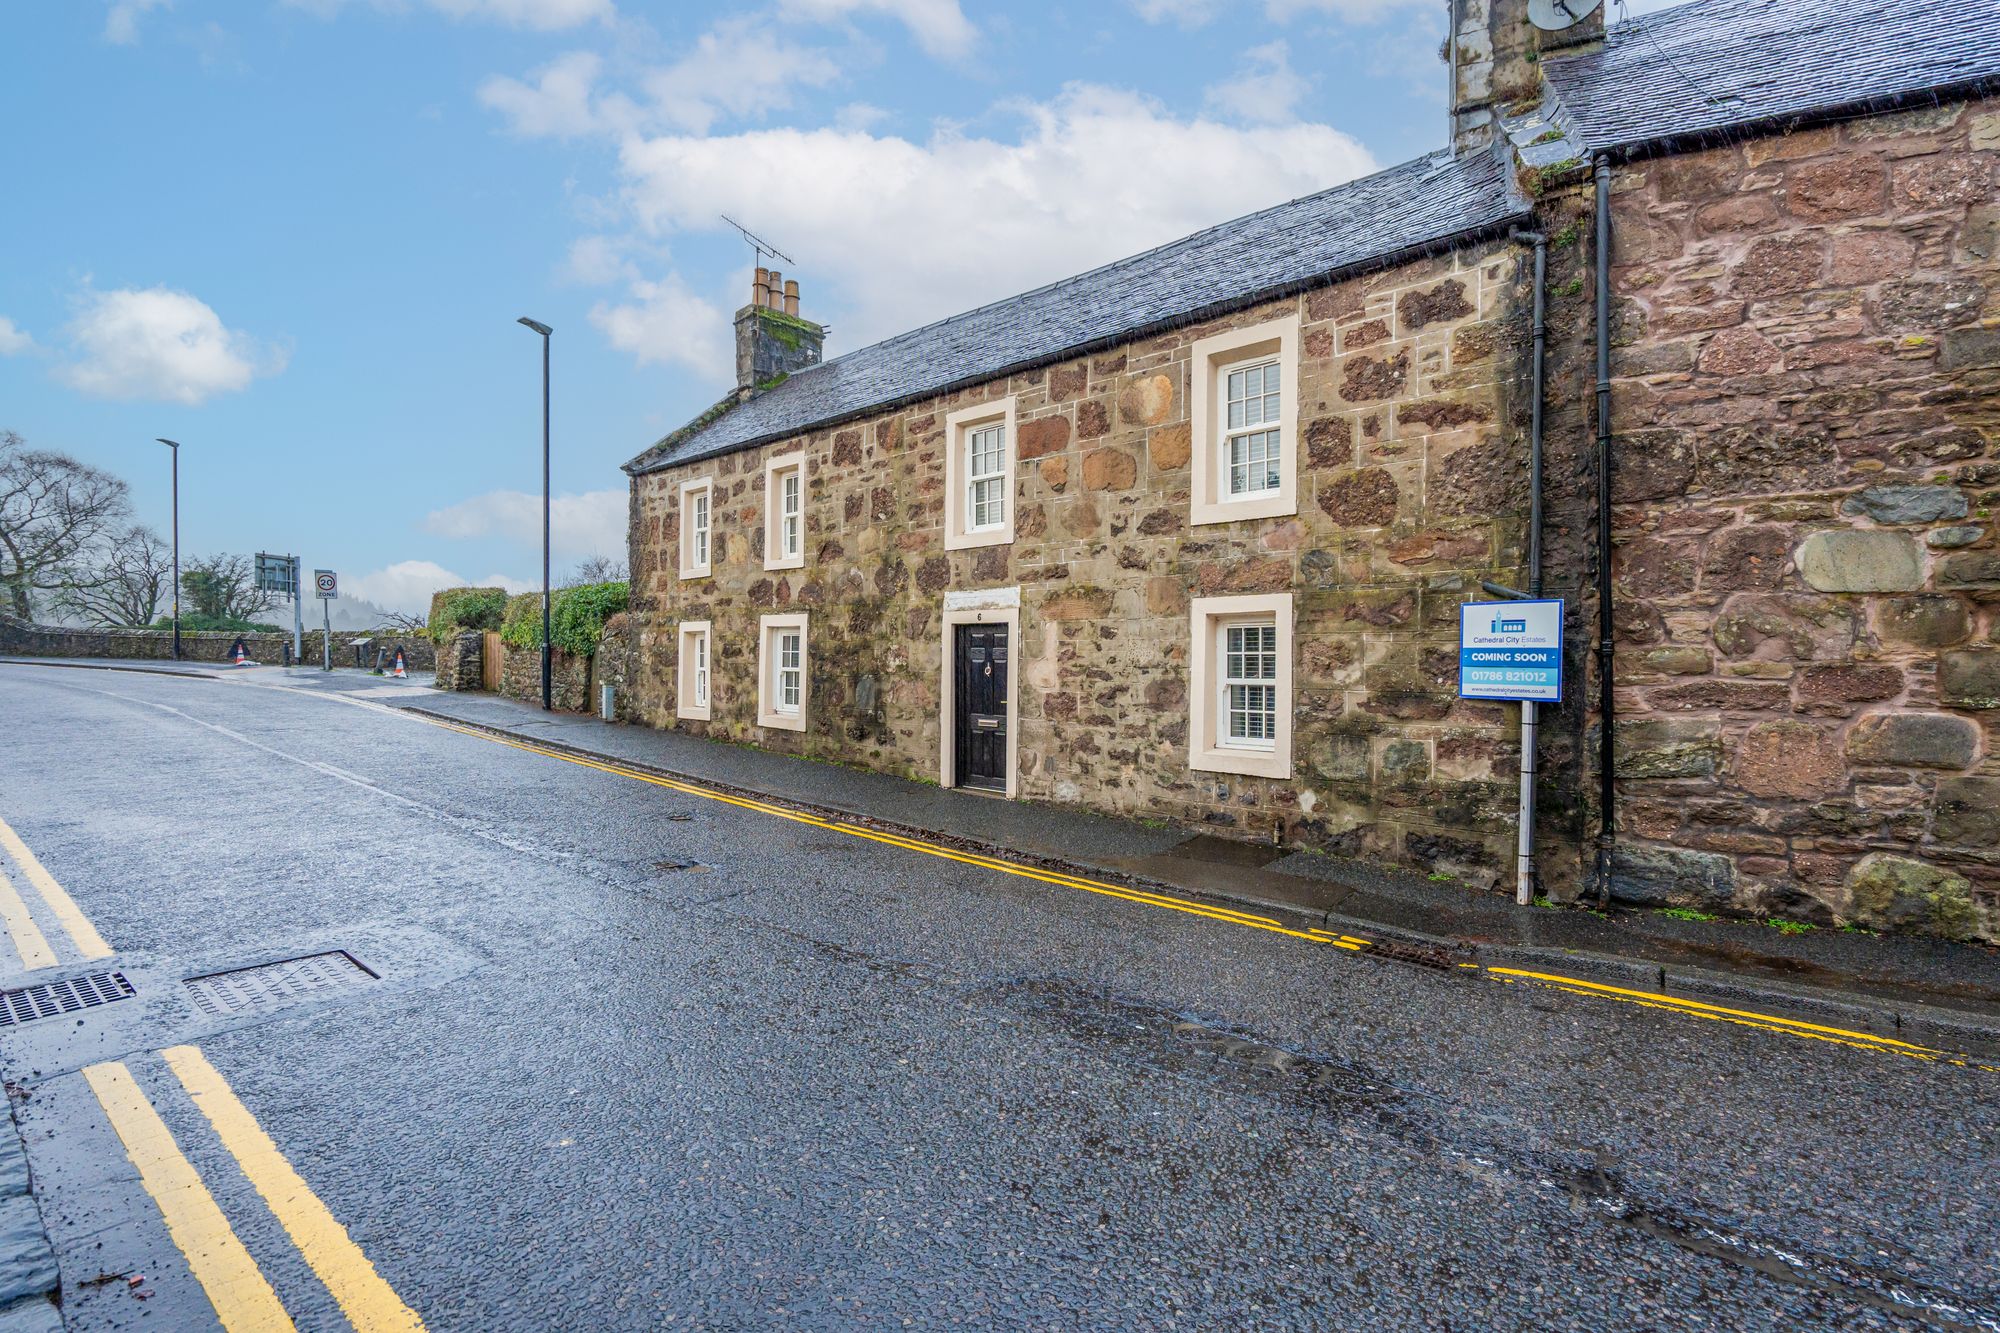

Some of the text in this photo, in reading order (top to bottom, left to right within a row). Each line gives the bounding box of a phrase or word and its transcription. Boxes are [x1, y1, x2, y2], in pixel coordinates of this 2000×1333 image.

[977, 613, 982, 621] 6
[1506, 636, 1520, 645] City
[1471, 653, 1547, 662] COMING SOON
[1471, 671, 1547, 682] 01786 821012
